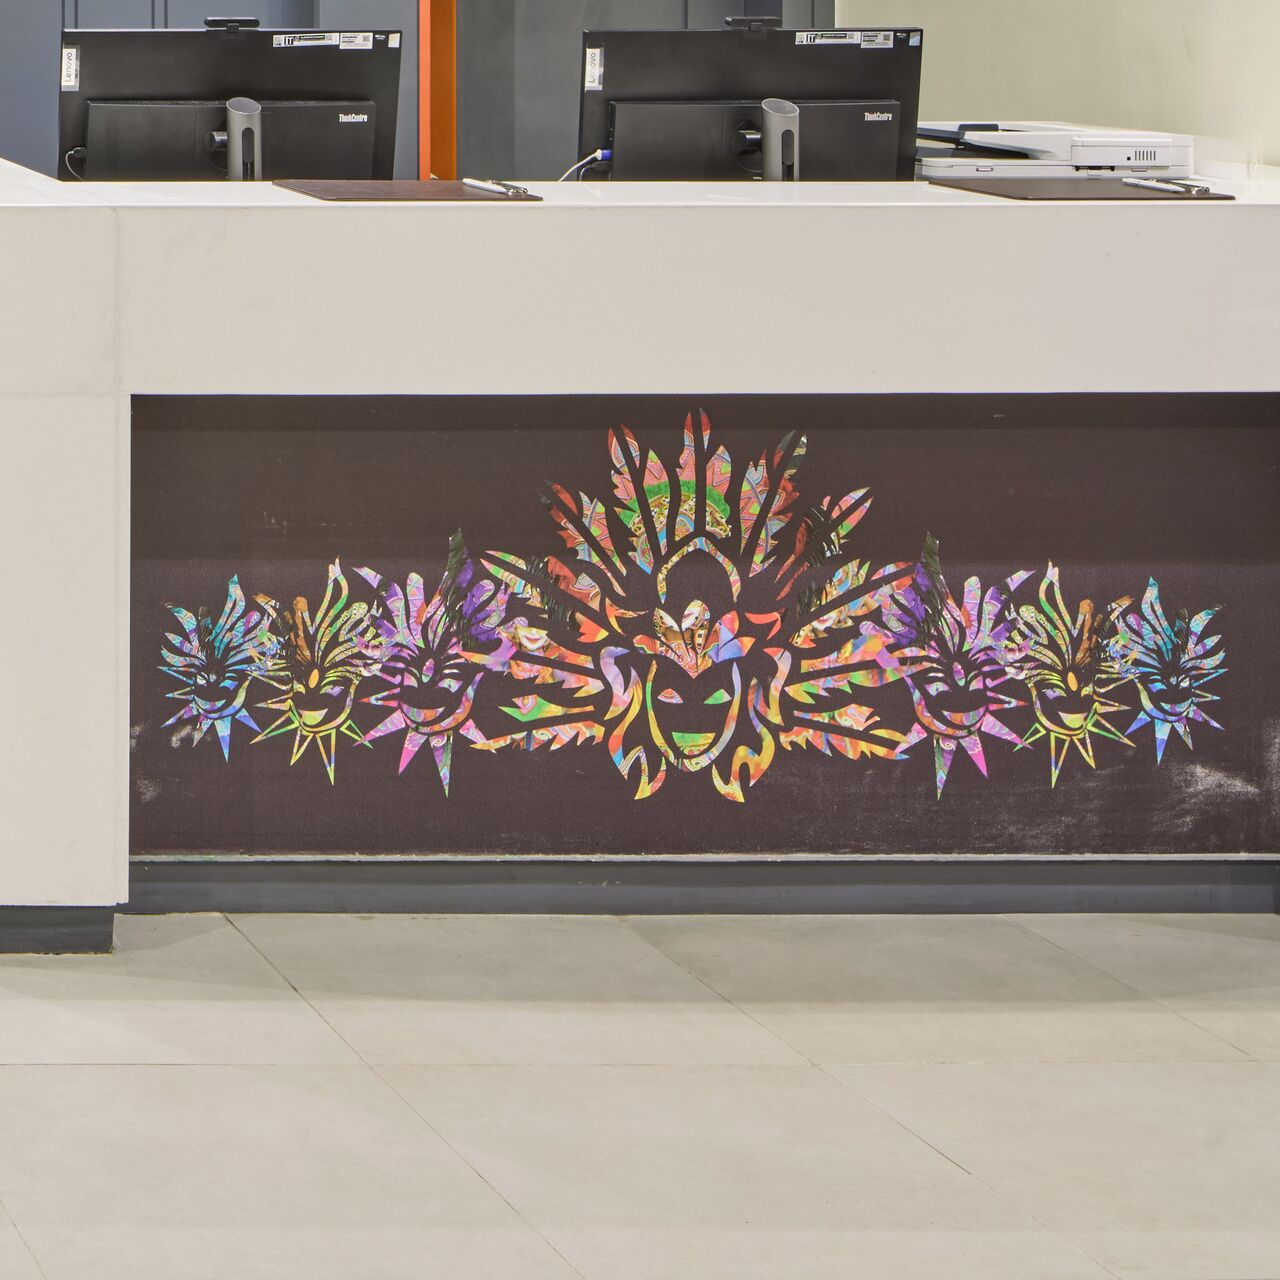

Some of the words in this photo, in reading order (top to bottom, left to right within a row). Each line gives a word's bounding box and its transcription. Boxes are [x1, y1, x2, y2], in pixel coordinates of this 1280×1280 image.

[65, 52, 73, 83] Lenovo
[588, 52, 596, 83] Lovo
[338, 113, 368, 123] ThinkCentre
[863, 111, 893, 121] ThinkCentre
